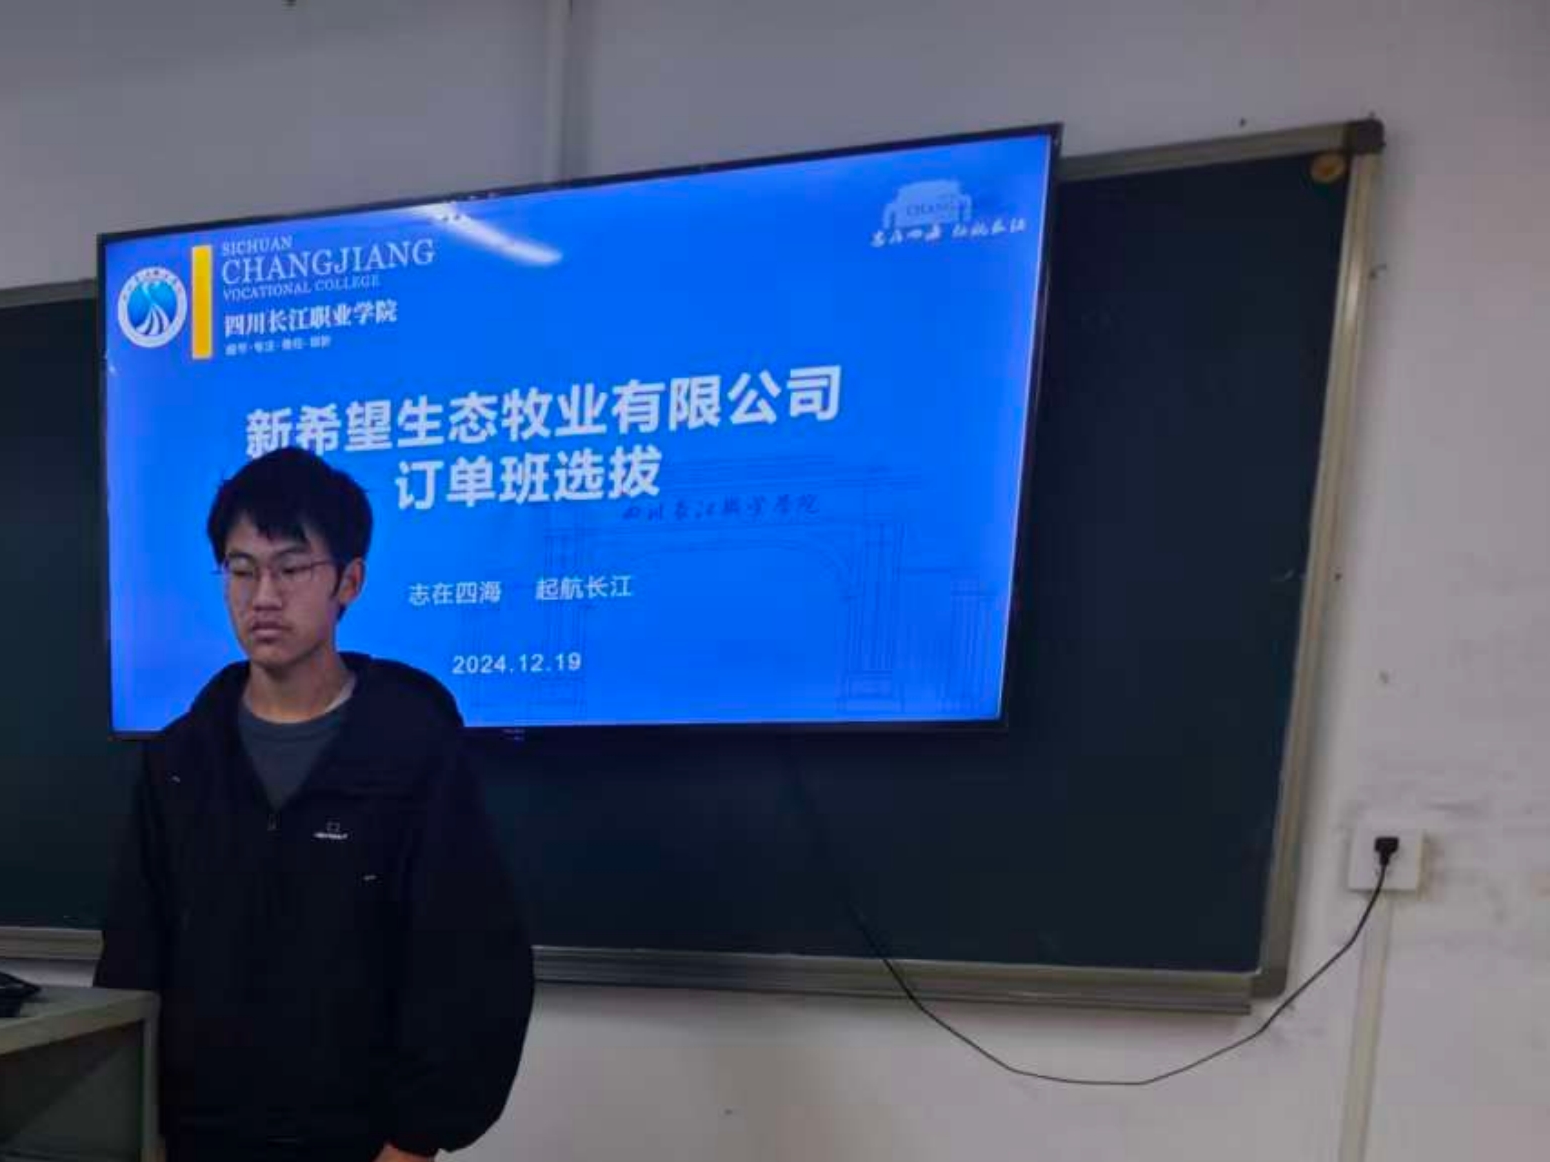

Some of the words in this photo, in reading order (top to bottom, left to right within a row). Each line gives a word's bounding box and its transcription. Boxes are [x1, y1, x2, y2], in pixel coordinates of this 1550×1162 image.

[222, 236, 292, 257] SICHUAN
[222, 238, 435, 285] CHANGJIANG
[223, 282, 311, 301] VOCATIONAL
[315, 275, 380, 292] COLLEGE
[224, 299, 397, 337] 四川长江职业学院
[245, 365, 842, 459] 新希望生态牧业有限公司
[395, 444, 662, 511] 订单班选拔
[408, 581, 502, 606] 志在四海
[535, 575, 633, 600] 起航长江
[452, 652, 582, 674] 2024.12.19
